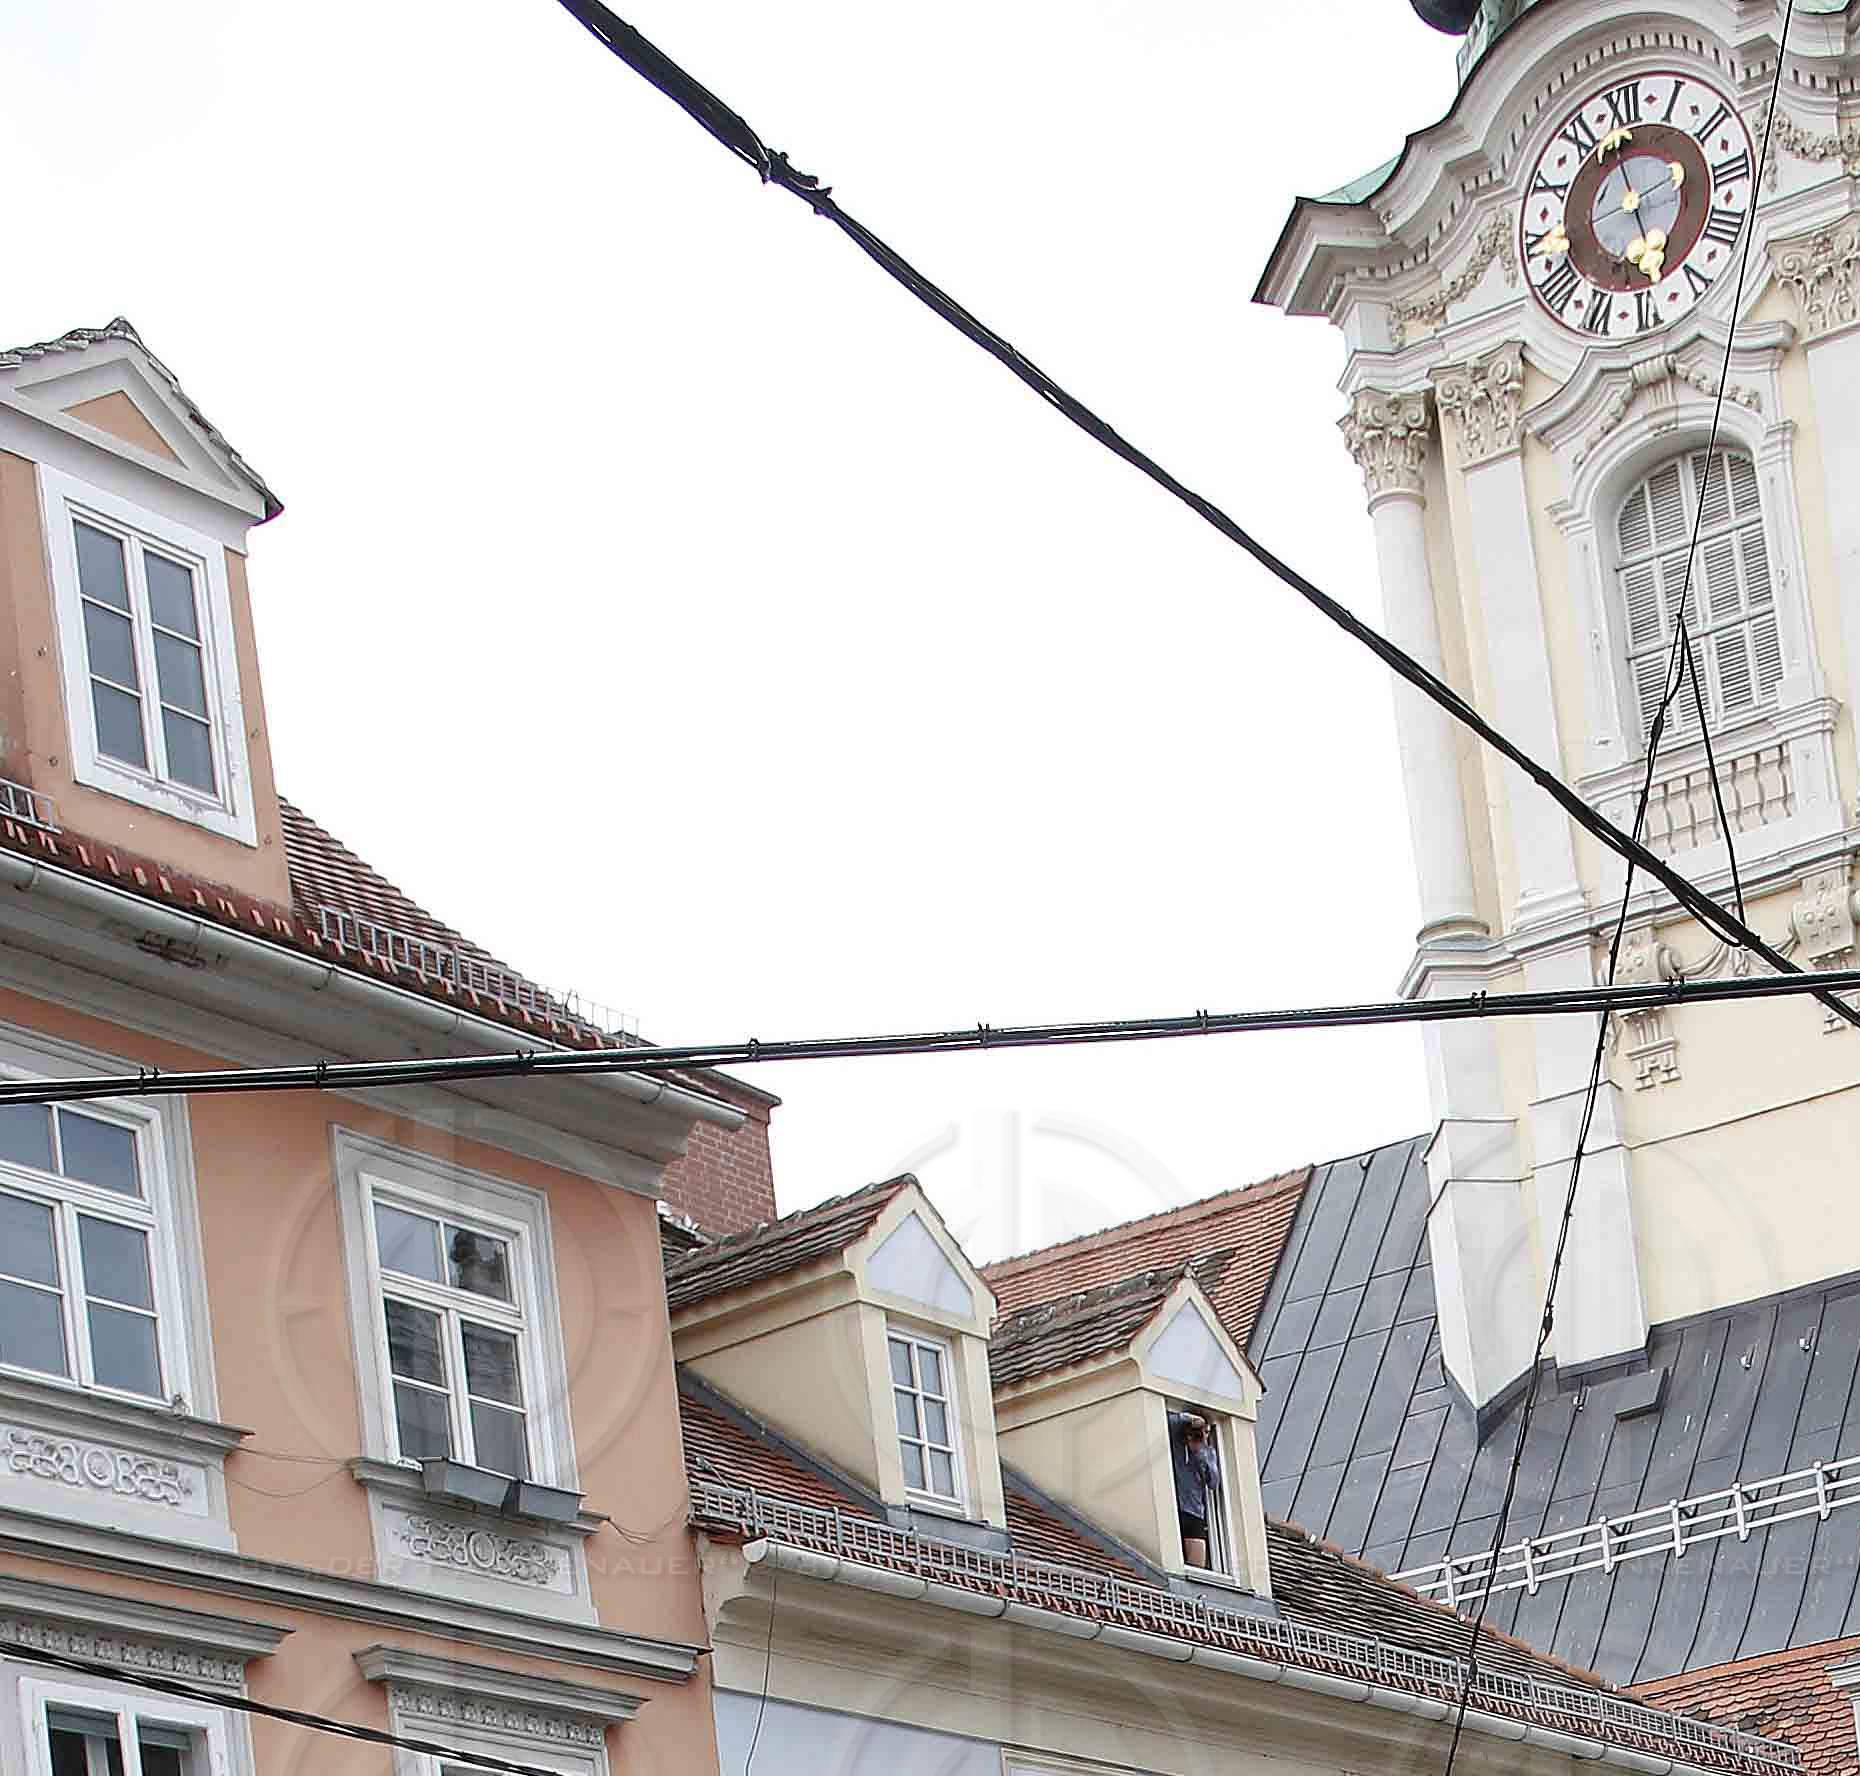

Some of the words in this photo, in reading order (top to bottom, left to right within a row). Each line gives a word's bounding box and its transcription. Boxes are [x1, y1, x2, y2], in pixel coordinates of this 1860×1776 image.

[1604, 81, 1642, 128] XII
[1661, 80, 1685, 122] I
[1560, 112, 1598, 162] XI
[1694, 103, 1731, 144] II
[1712, 149, 1750, 187] III
